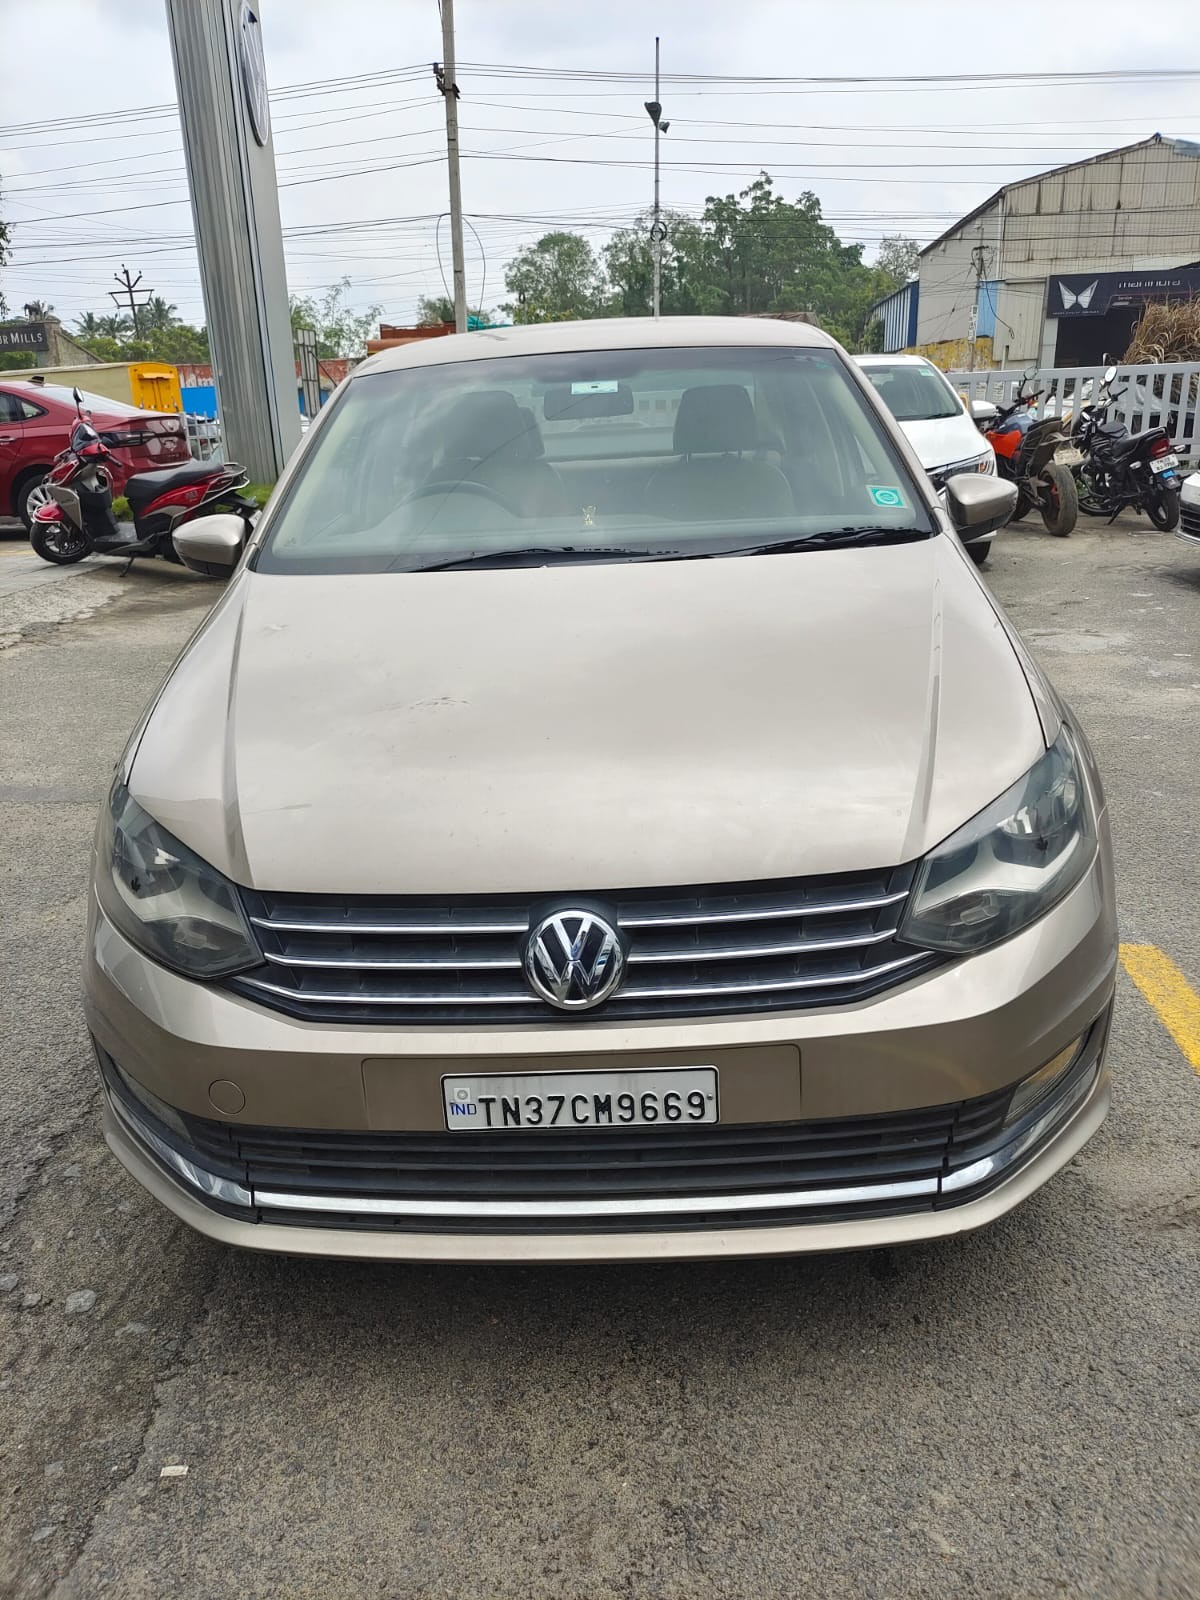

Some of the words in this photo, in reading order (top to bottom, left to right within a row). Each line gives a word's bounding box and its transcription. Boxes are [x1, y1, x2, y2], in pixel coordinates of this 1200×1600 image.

[10, 332, 43, 344] MILLS
[450, 1103, 477, 1116] IND
[479, 1092, 706, 1127] TN37CM9669
